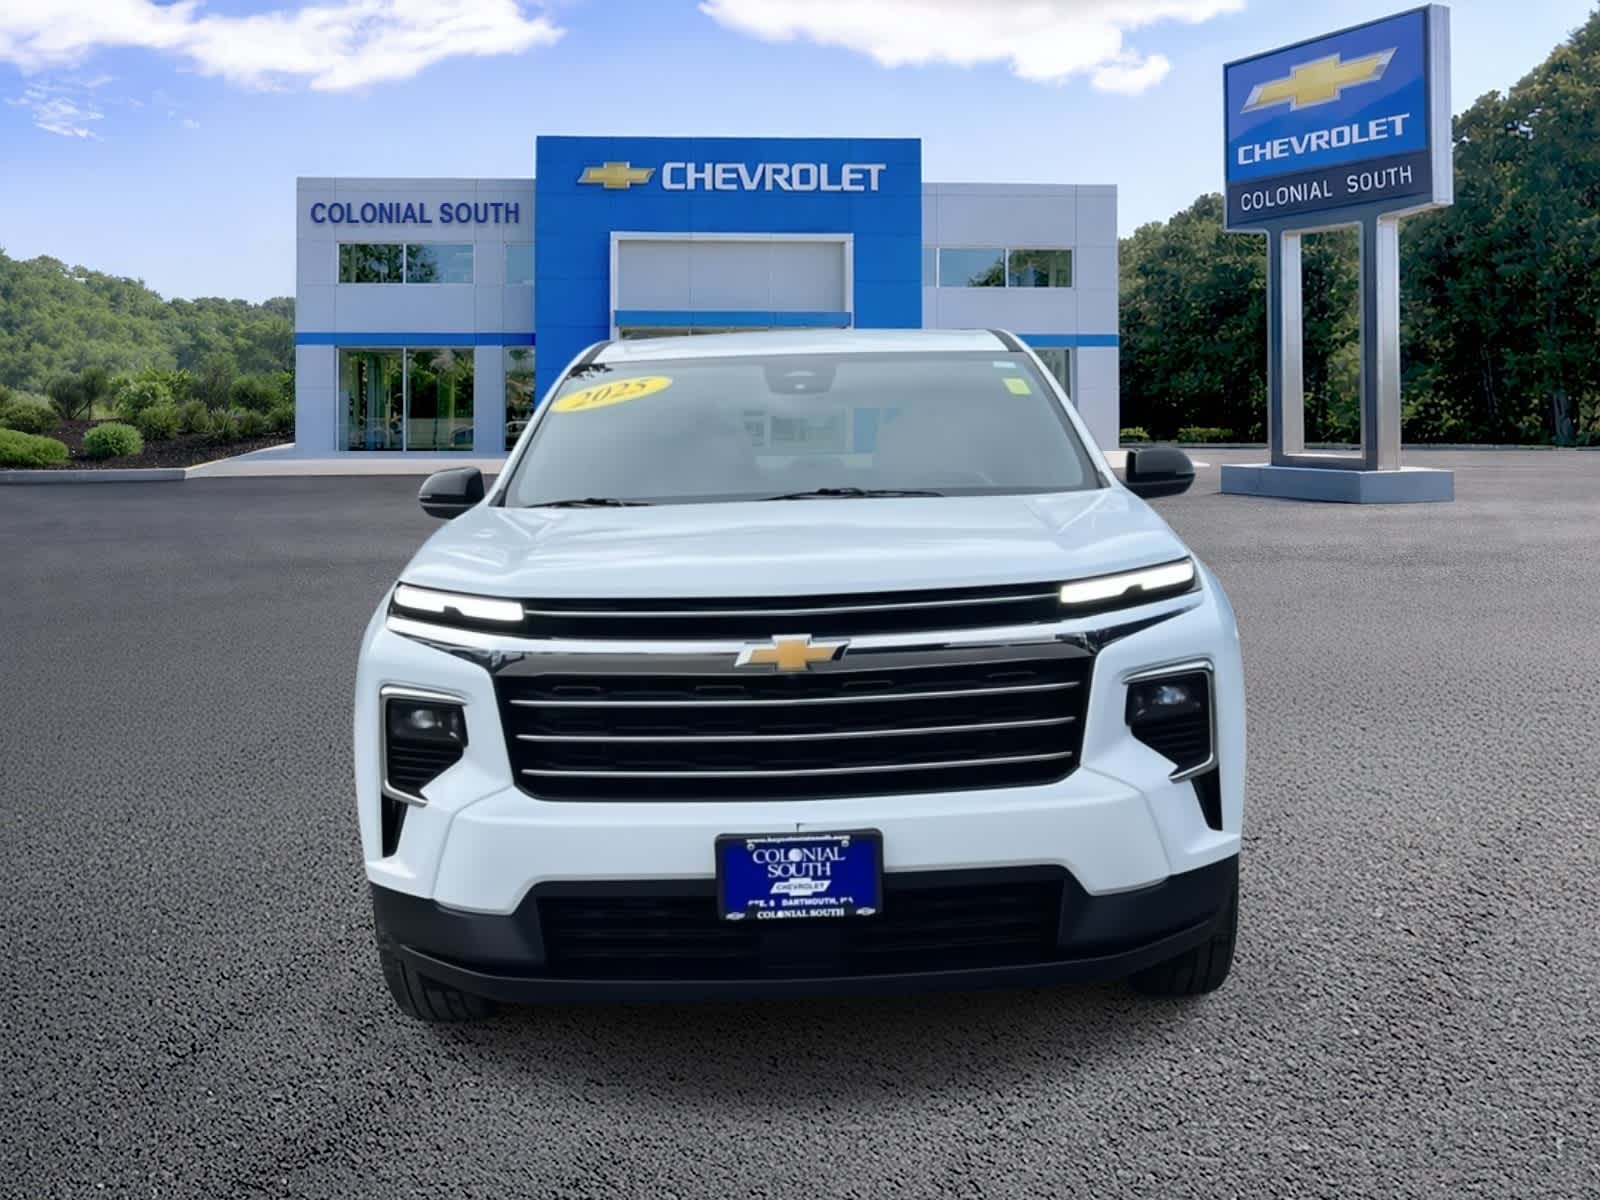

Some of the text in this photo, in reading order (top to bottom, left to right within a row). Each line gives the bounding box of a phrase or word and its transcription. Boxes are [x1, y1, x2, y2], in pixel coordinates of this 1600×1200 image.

[1237, 113, 1410, 165] CHEVROLET
[662, 161, 887, 192] CHEVROLET
[1240, 165, 1413, 211] COLONIAL SOUTH
[310, 202, 520, 225] COLONIAL SOUTH
[566, 378, 652, 409] 2025
[752, 847, 846, 864] COLONIAL
[767, 862, 831, 878] SOUTH
[775, 882, 825, 891] CHEVROLET
[757, 908, 845, 919] COLONIAL SOUTH
